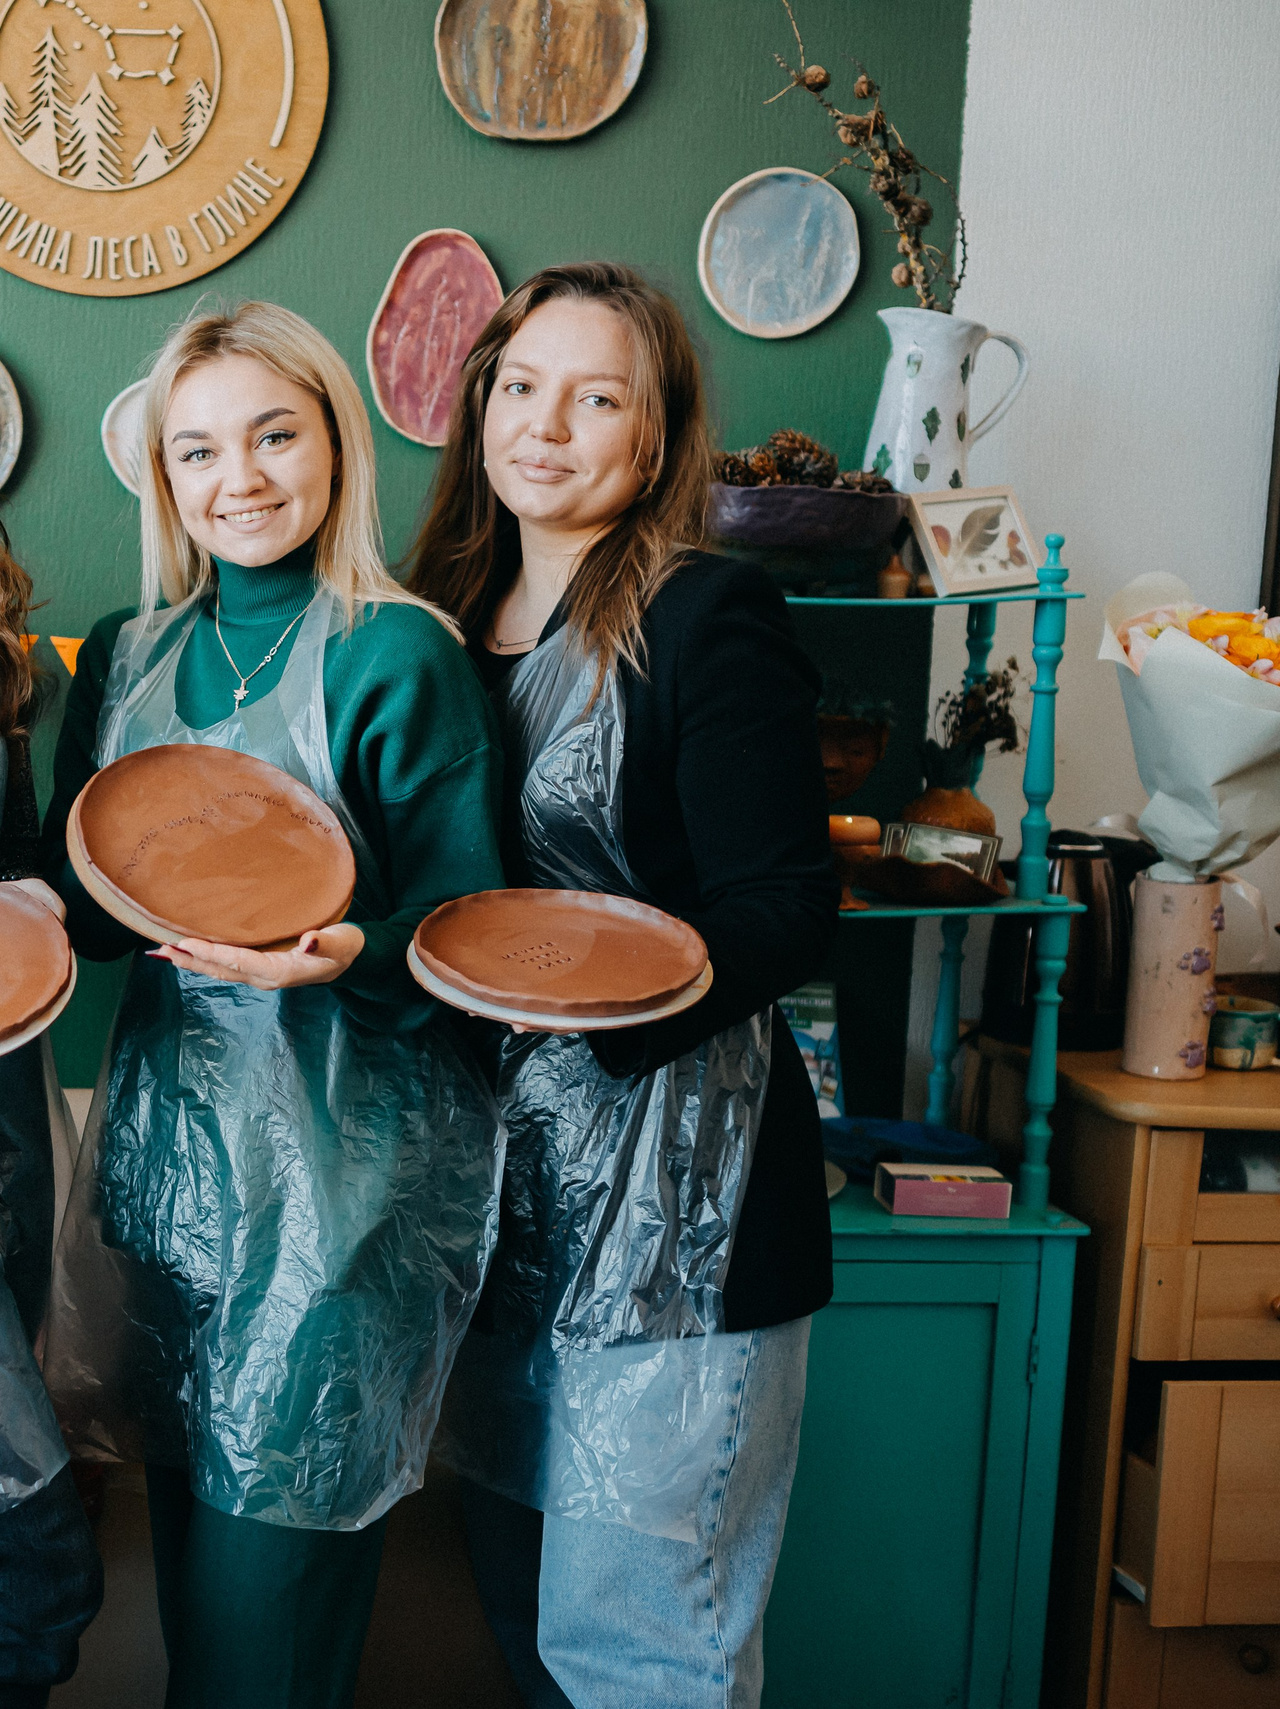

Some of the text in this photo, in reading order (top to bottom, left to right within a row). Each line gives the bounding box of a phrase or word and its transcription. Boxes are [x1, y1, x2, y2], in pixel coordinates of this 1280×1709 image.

[81, 232, 162, 281] ЛЕСА
[165, 224, 189, 267] В
[187, 157, 287, 254] ГЛИНЕ
